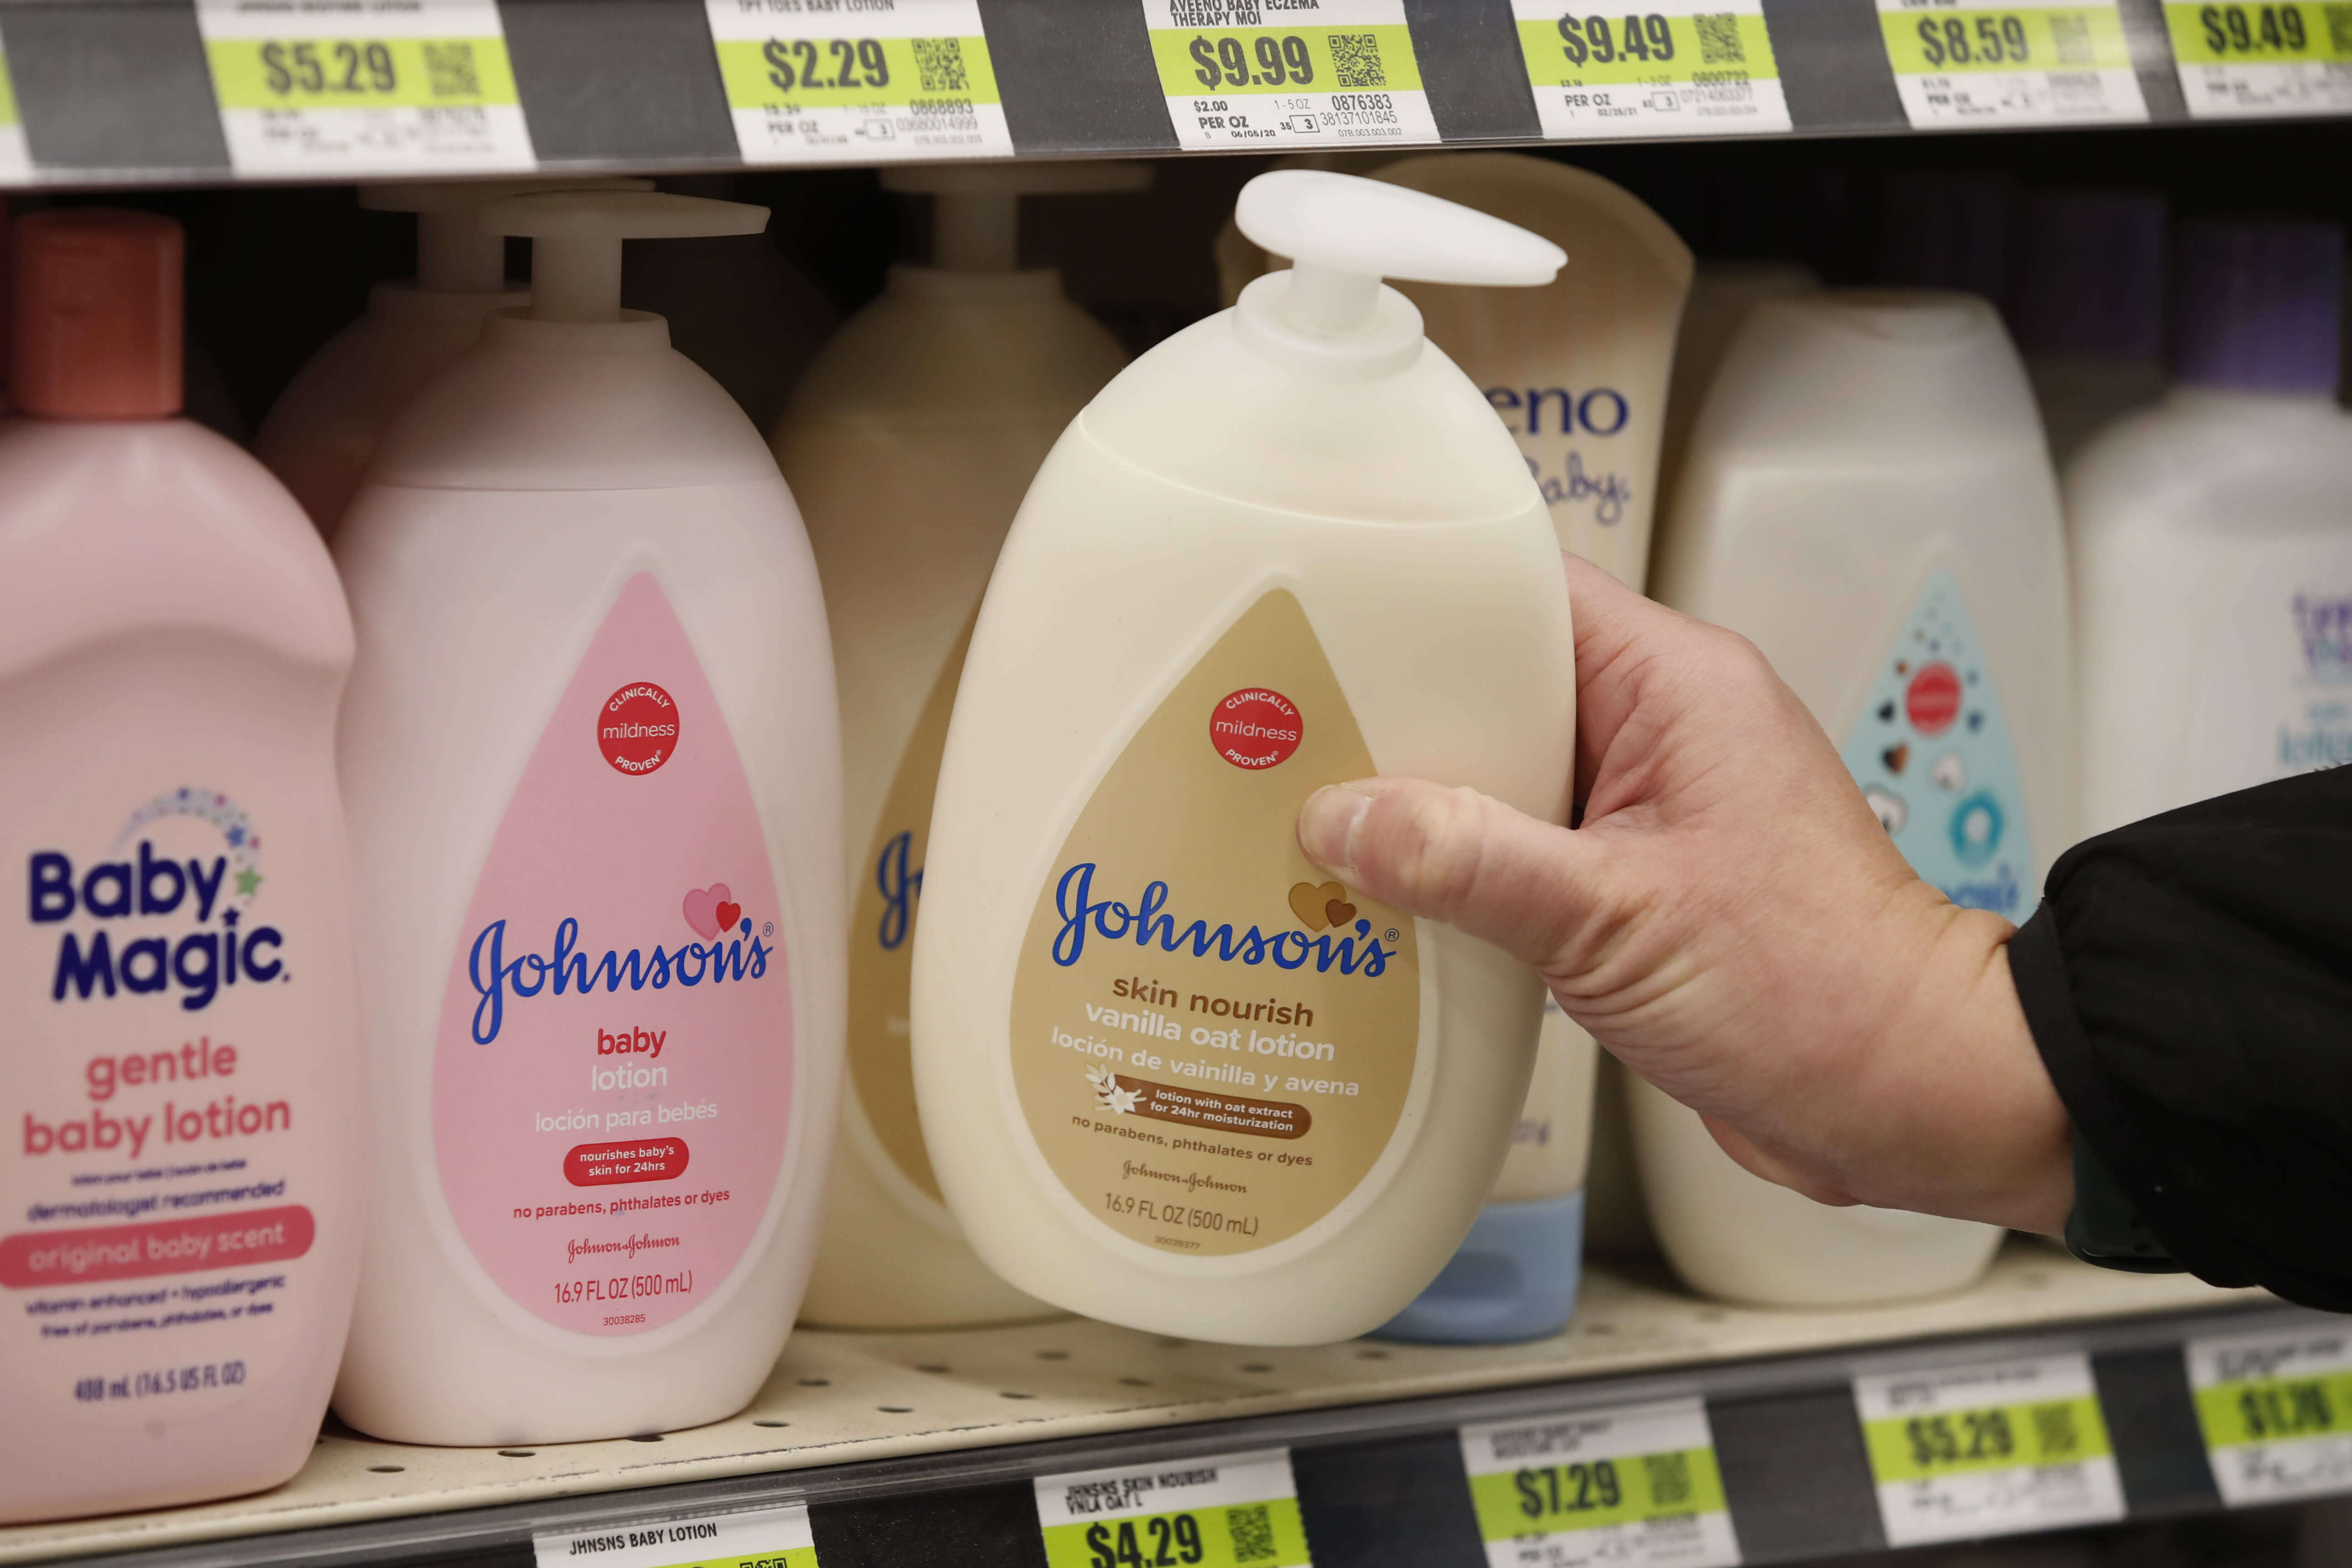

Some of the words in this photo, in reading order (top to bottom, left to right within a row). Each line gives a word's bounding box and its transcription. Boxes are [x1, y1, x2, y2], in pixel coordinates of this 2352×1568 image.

[807, 0, 841, 11] BABY
[846, 0, 895, 11] LOTION
[1170, 0, 1222, 12] AVEENO
[1227, 0, 1260, 11] BABY
[1266, 0, 1320, 10] ECZEMA
[1171, 11, 1230, 26] THERAPY
[1236, 11, 1262, 25] MOI
[1558, 13, 1675, 67] $9.49
[1918, 15, 2029, 69] $8.59
[2200, 4, 2307, 55] $9.49
[261, 39, 398, 96] $5.29
[763, 37, 890, 92] $2.29
[1189, 35, 1314, 91] $9.99
[910, 98, 974, 115] 0868893
[1194, 100, 1228, 113] $2.00
[1331, 94, 1392, 111] 0876383
[1565, 94, 1588, 107] PER
[1593, 94, 1611, 106] OZ
[1198, 116, 1224, 129] PER
[1229, 115, 1249, 128] OZ
[1280, 122, 1292, 130] 35
[1304, 119, 1313, 129] 3
[1320, 110, 1397, 126] 38137101845
[1231, 130, 1276, 138] 06/05/20
[609, 687, 670, 711] CLINICALLY
[1226, 692, 1294, 715] CLINICALLY
[603, 722, 675, 739] mildness
[1216, 720, 1297, 741] mildness
[28, 839, 227, 923] Baby
[1113, 976, 1178, 1008] skin
[1189, 991, 1314, 1027] nourish
[597, 1026, 666, 1059] baby
[1085, 1002, 1182, 1041] vanilla
[1190, 1026, 1241, 1051] oat
[1248, 1030, 1335, 1062] lotion
[85, 1034, 238, 1101] gentle
[592, 1061, 667, 1091] lotion
[1052, 1026, 1123, 1061] loción
[1131, 1049, 1162, 1070] de
[1170, 1058, 1256, 1086] vainilla
[1263, 1074, 1278, 1093] y
[1285, 1076, 1360, 1096] avena
[536, 1108, 599, 1132] loción
[606, 1107, 652, 1132] para
[658, 1098, 717, 1125] bebés
[1150, 1101, 1168, 1112] for
[1171, 1105, 1200, 1119] 24hr
[1203, 1112, 1293, 1131] moisturization
[1156, 1089, 1191, 1105] lotion
[1194, 1096, 1221, 1110] with
[1225, 1102, 1246, 1113] oat
[1248, 1106, 1293, 1119] extract
[22, 1112, 152, 1159] baby
[164, 1095, 291, 1144] lotion
[1072, 1115, 1090, 1128] no
[1094, 1120, 1168, 1147] parabens,
[1172, 1138, 1252, 1159] phthalates
[1257, 1151, 1273, 1162] or
[1278, 1153, 1313, 1166] dyes
[580, 1147, 636, 1162] nourishes
[639, 1144, 675, 1159] baby's
[588, 1164, 612, 1176] skin
[615, 1163, 631, 1174] for
[634, 1161, 665, 1173] 24hrs
[513, 1207, 532, 1218] no
[536, 1202, 606, 1220] parabens,
[610, 1195, 681, 1215] phthalates
[684, 1194, 698, 1204] or
[701, 1190, 730, 1206] dyes
[1105, 1192, 1135, 1214] 16.9
[1138, 1200, 1158, 1221] FL
[1163, 1205, 1184, 1225] OZ
[1188, 1207, 1223, 1231] (500
[1226, 1217, 1258, 1237] mL)
[28, 1237, 141, 1274] original
[146, 1232, 213, 1261] baby
[216, 1222, 285, 1253] scent
[555, 1282, 582, 1303] 16.9
[587, 1280, 605, 1301] FL
[609, 1278, 628, 1298] OZ
[631, 1274, 662, 1299] (500
[665, 1269, 692, 1294] mL)
[603, 1314, 646, 1326] 30038285
[1514, 1459, 1621, 1521] $7.29
[569, 1535, 626, 1556] JHNSNS
[629, 1529, 664, 1547] BABY
[669, 1523, 718, 1542] LOTION
[1086, 1513, 1203, 1568] $4.29
